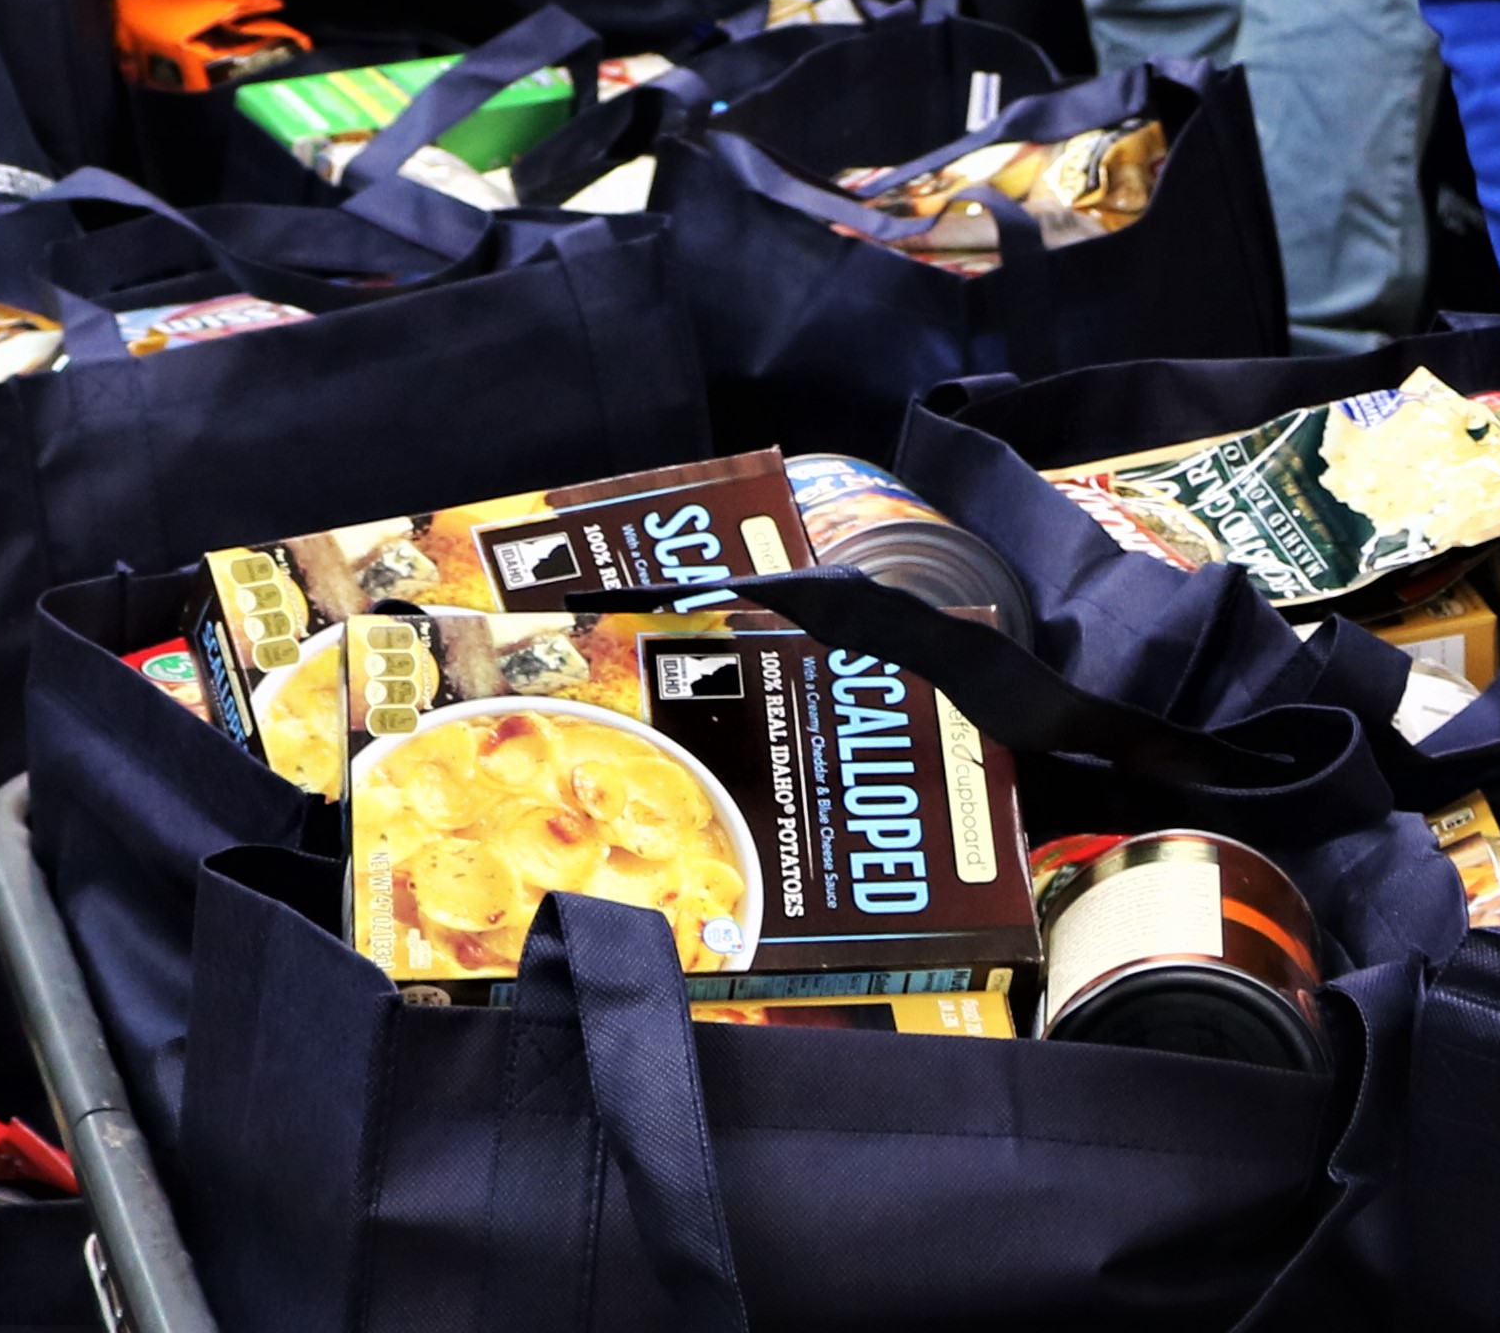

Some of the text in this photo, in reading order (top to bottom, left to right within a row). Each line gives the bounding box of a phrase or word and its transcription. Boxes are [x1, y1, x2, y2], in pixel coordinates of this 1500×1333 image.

[583, 524, 610, 566] 100%
[500, 549, 524, 585] IDAHO
[661, 659, 680, 697] IDAHO
[760, 650, 783, 693] 100%
[802, 656, 816, 679] With
[766, 694, 789, 744] REAL
[805, 691, 822, 734] Creamy
[810, 734, 827, 787] Cheddar
[828, 648, 931, 915] SCALLOPED
[817, 797, 831, 826] Blue
[955, 760, 988, 871] cupboard
[777, 816, 805, 919] POTATOES
[819, 826, 835, 871] Cheese
[824, 871, 838, 910] Sauce
